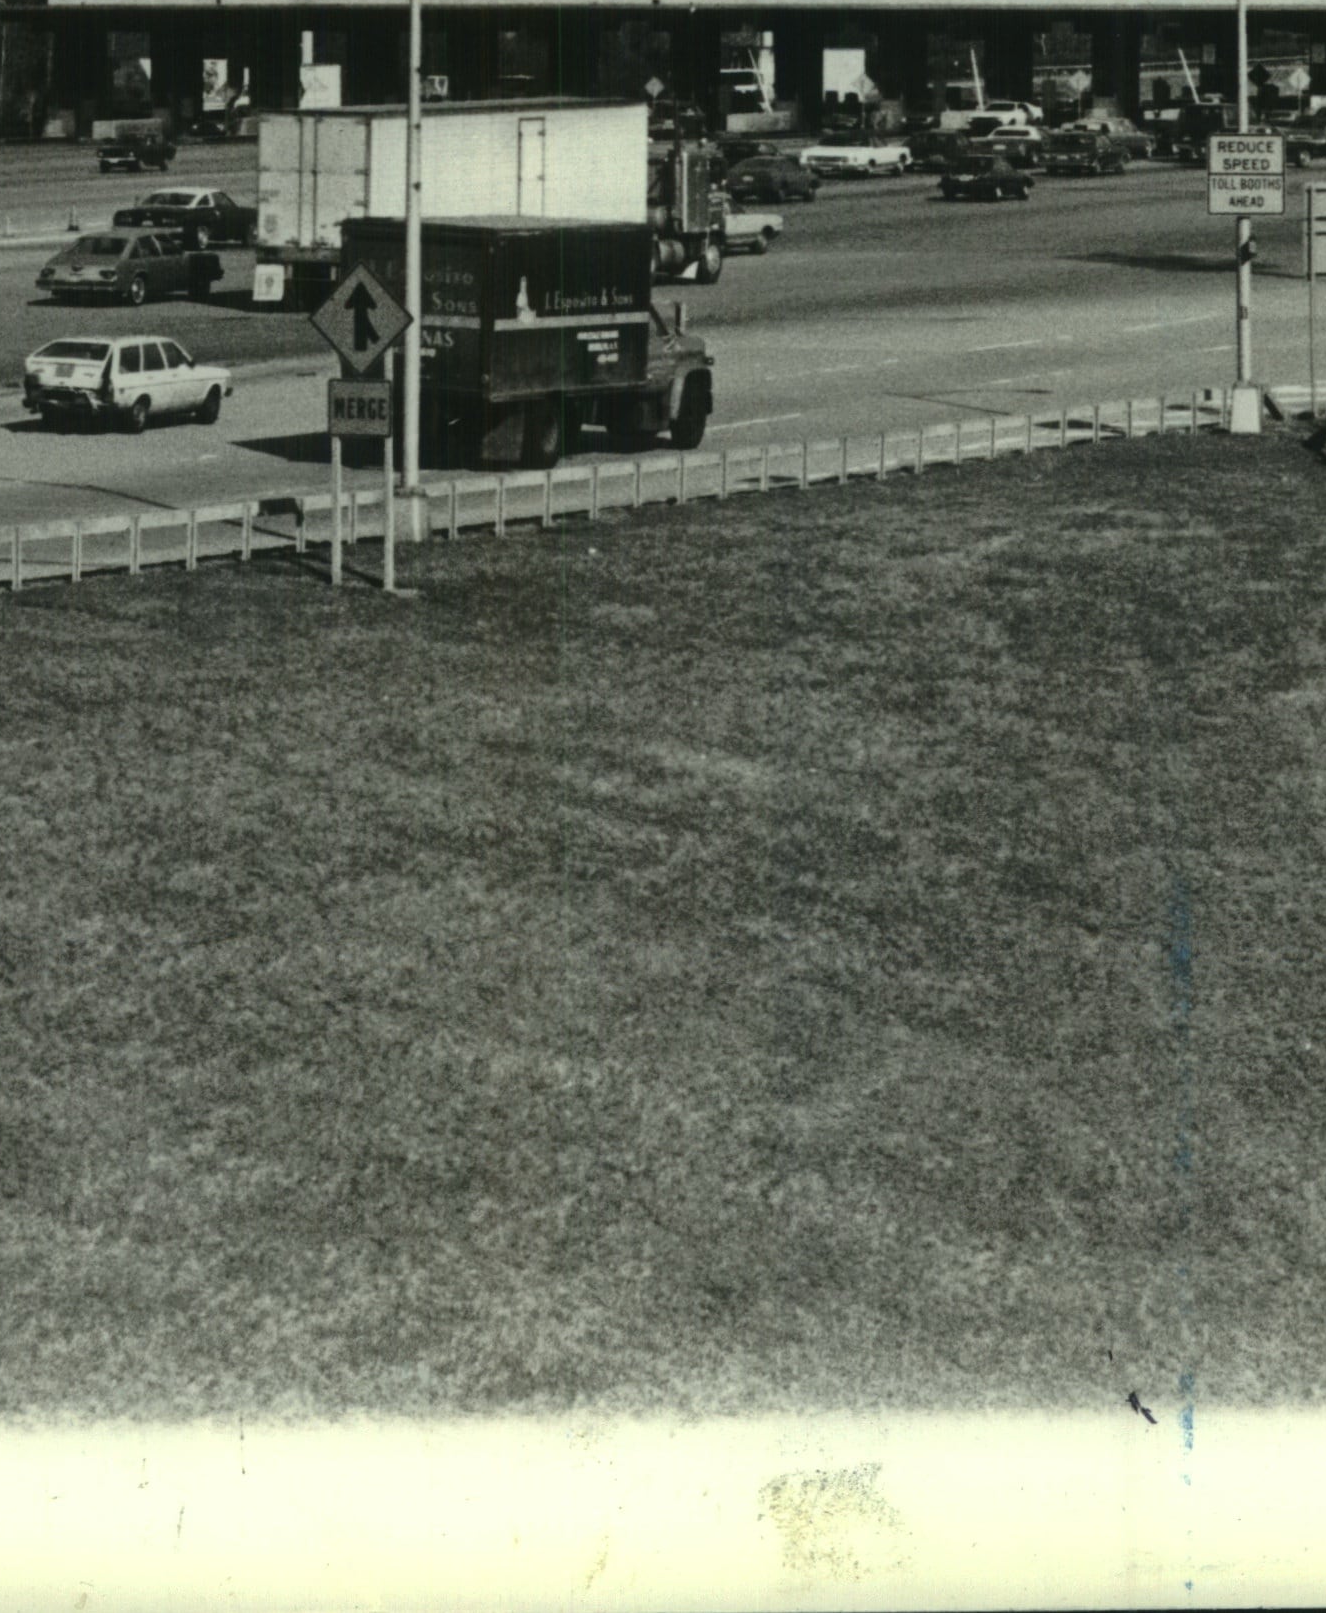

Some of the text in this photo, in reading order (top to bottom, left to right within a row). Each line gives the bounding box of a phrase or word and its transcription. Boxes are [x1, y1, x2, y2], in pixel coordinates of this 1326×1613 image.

[1217, 141, 1275, 154] REDUCE
[1223, 157, 1270, 171] SPEED
[1212, 178, 1282, 191] TOLL BOOTHS
[1229, 196, 1264, 208] AHEAD
[333, 396, 387, 420] MERGE
